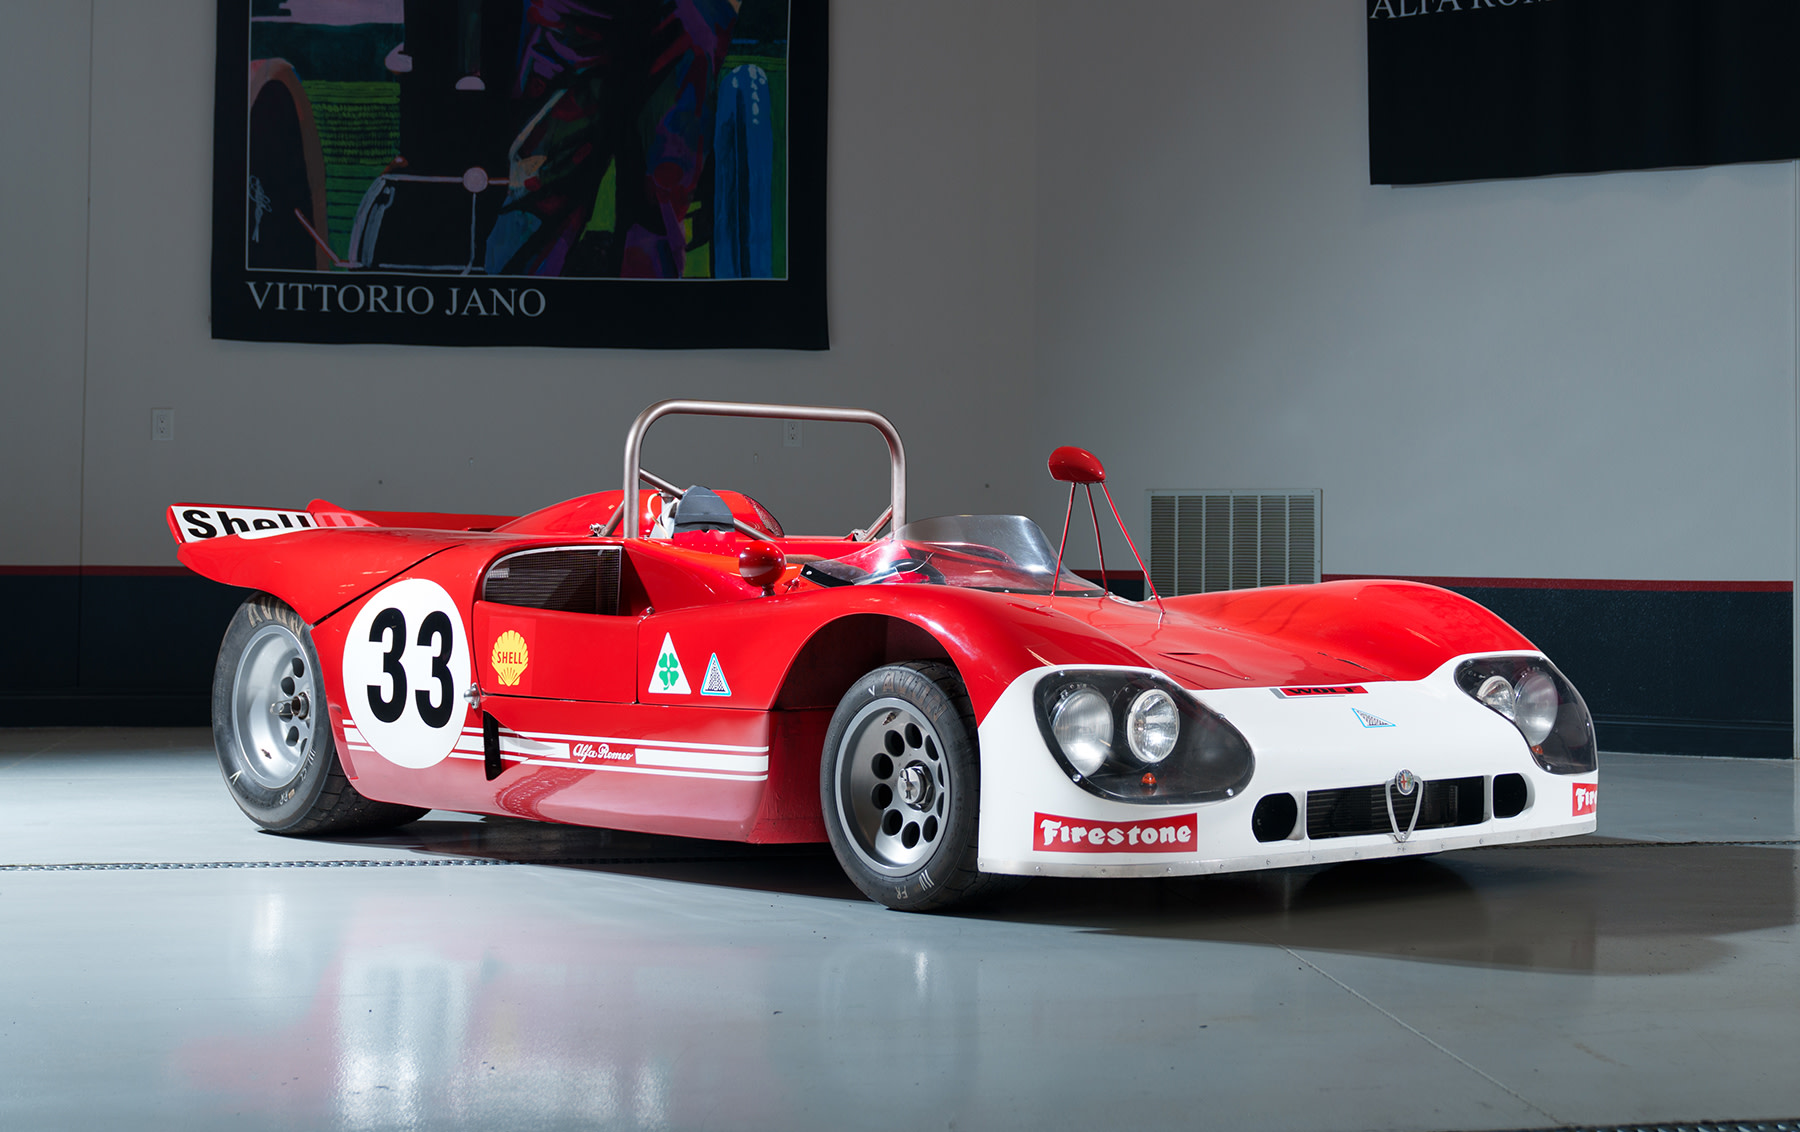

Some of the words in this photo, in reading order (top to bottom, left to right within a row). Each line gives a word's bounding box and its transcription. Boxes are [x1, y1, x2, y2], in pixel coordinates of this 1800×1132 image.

[246, 281, 434, 315] VITTORIO
[445, 288, 546, 317] JANO
[367, 607, 454, 728] 33
[497, 651, 522, 664] SHELL
[573, 743, 597, 762] Alfa
[598, 743, 633, 760] Romeo
[1040, 819, 1192, 846] Firestone
